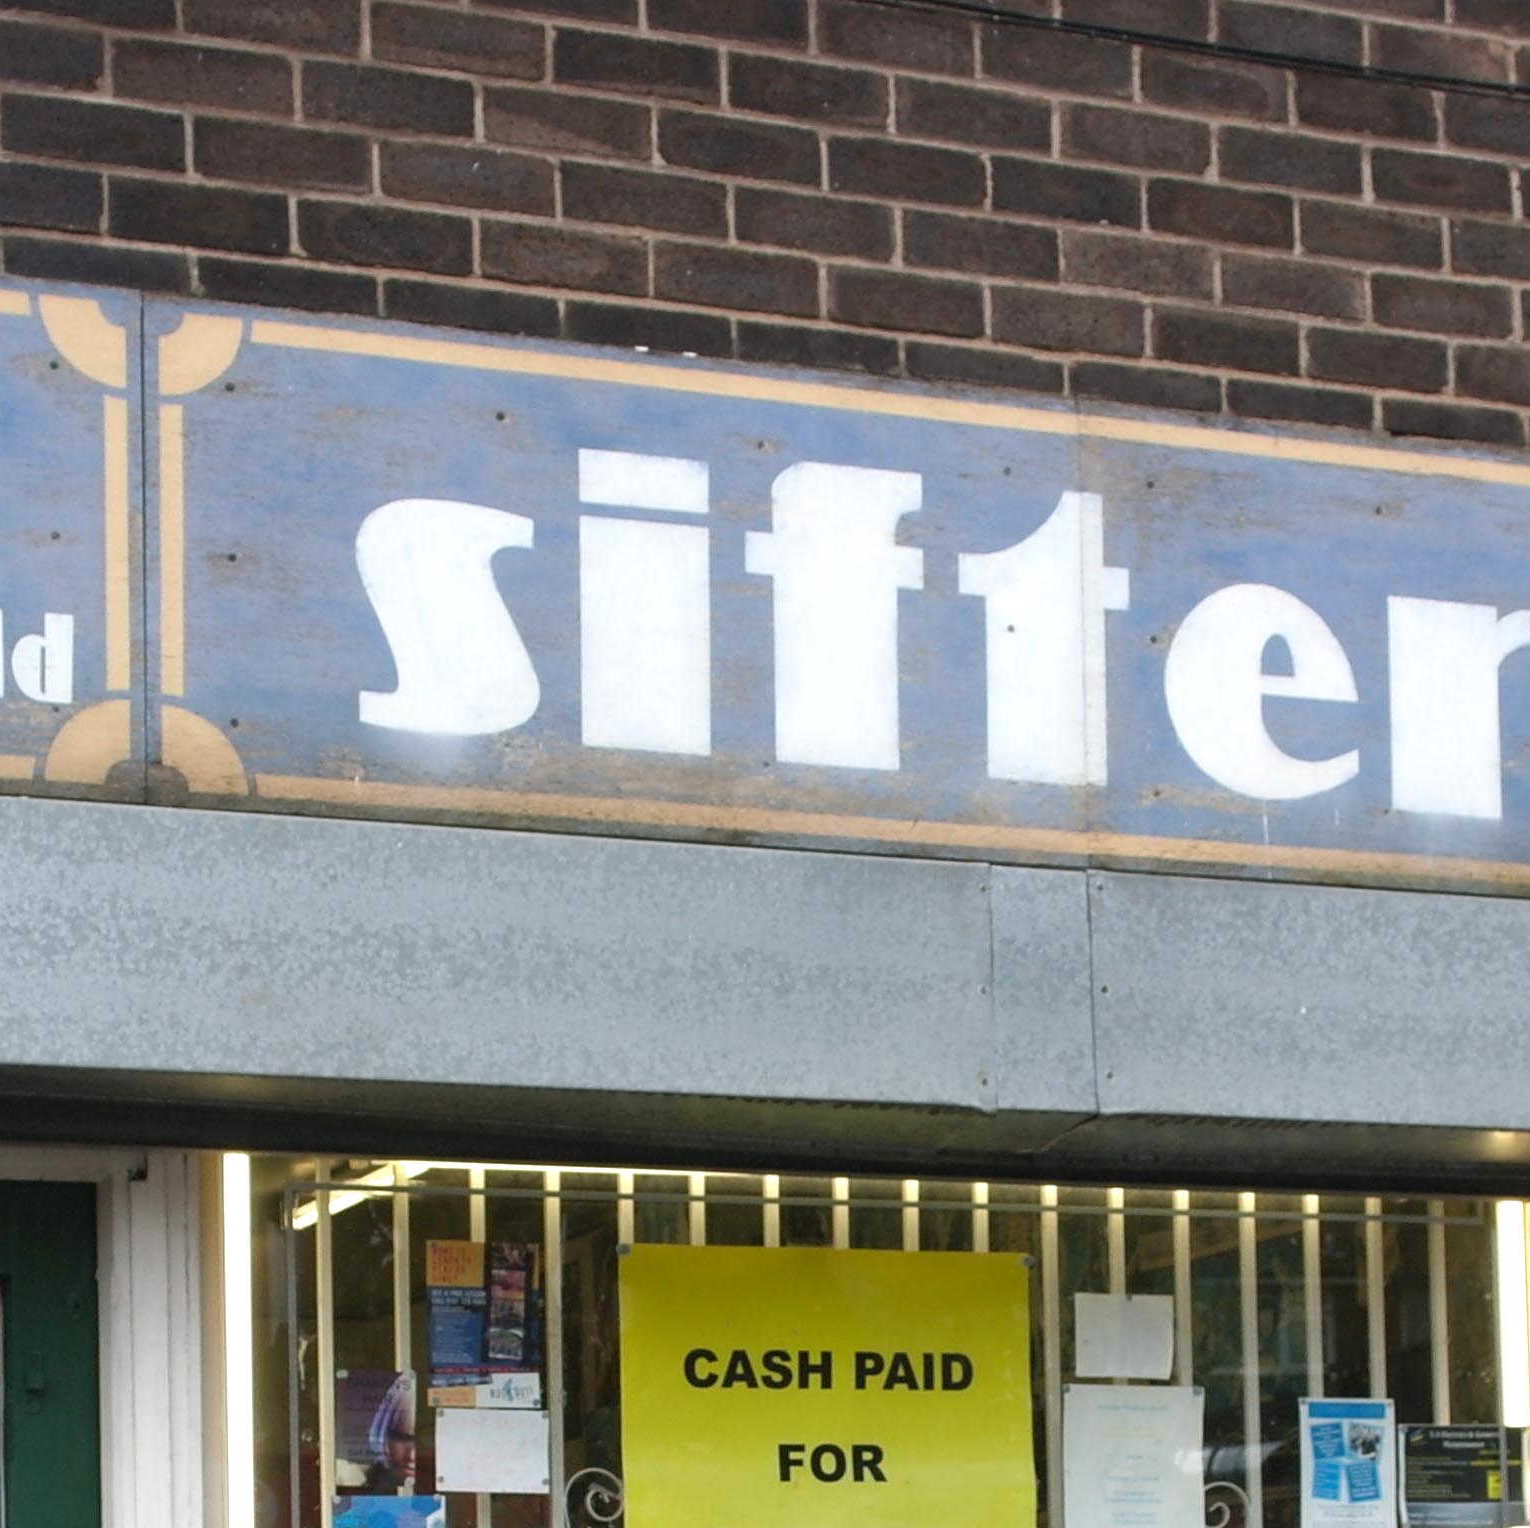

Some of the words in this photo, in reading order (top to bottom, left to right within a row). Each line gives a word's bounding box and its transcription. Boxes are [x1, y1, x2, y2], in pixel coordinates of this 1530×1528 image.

[684, 1349, 832, 1390] CASH
[855, 1351, 974, 1391] PAID
[778, 1444, 888, 1483] FOR
